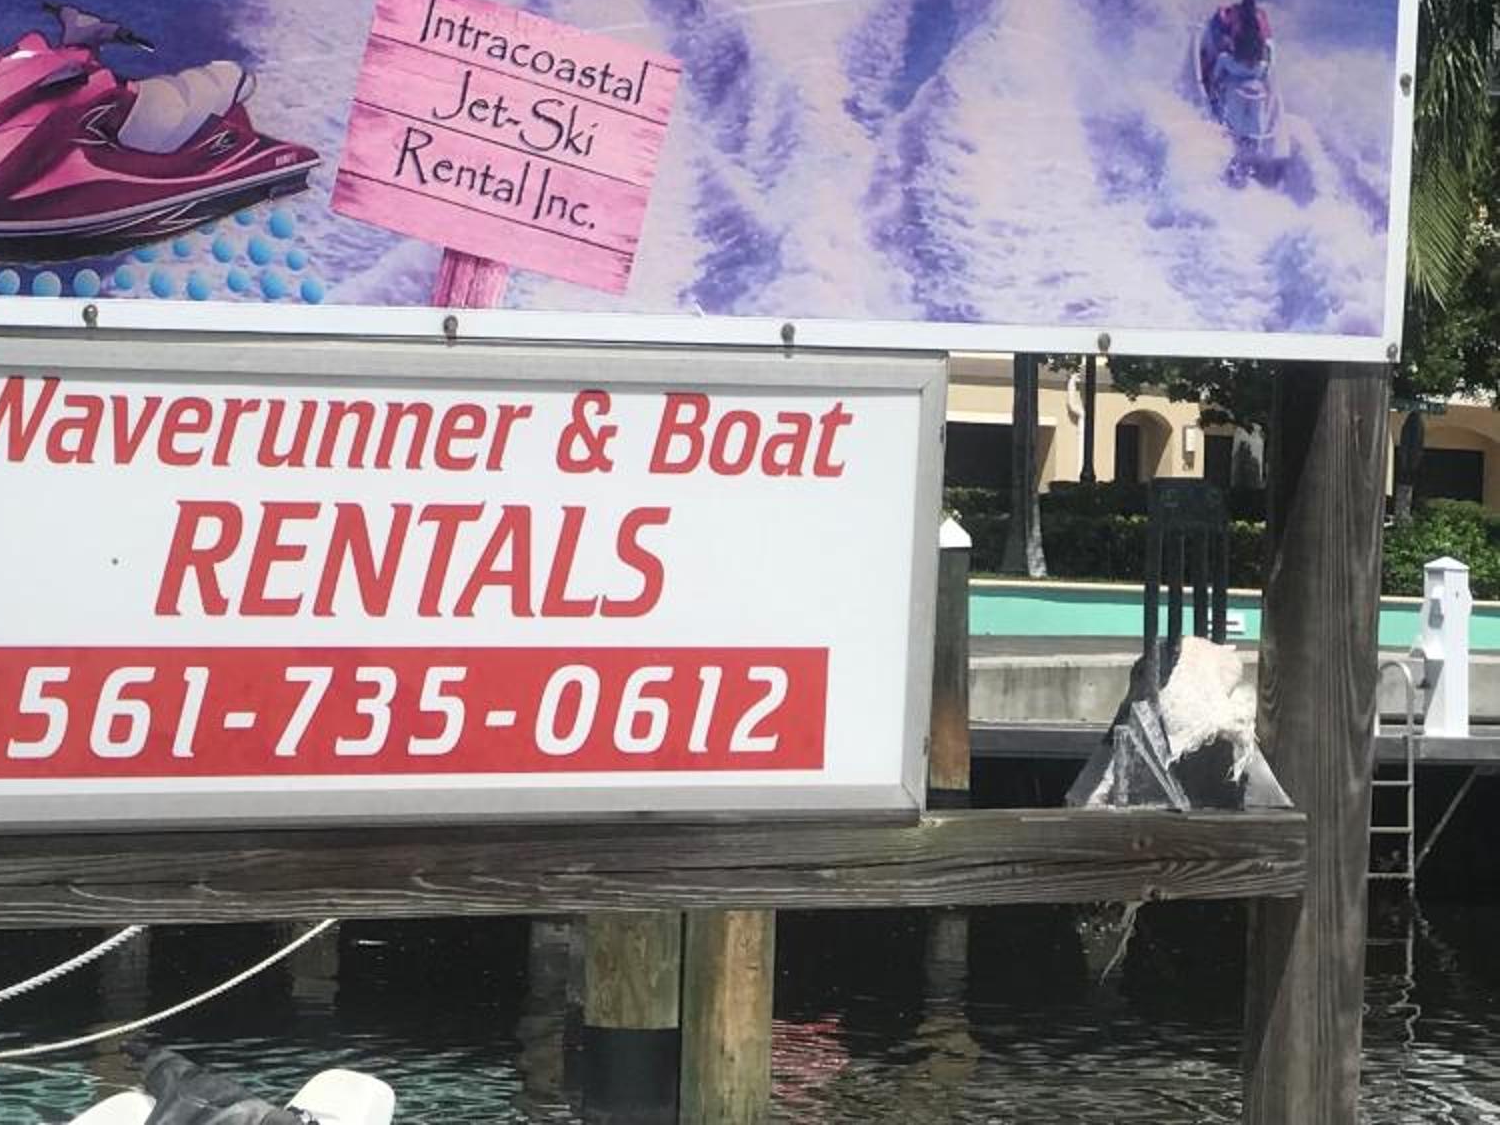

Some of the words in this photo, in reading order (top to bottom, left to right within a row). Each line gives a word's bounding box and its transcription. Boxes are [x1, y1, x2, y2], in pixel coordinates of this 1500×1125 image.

[394, 126, 530, 206] Rental
[532, 167, 596, 230] Inc.
[555, 389, 619, 473] &
[649, 392, 854, 478] Boat
[153, 500, 672, 618] RENTALS
[6, 665, 792, 760] 561-735-0612
